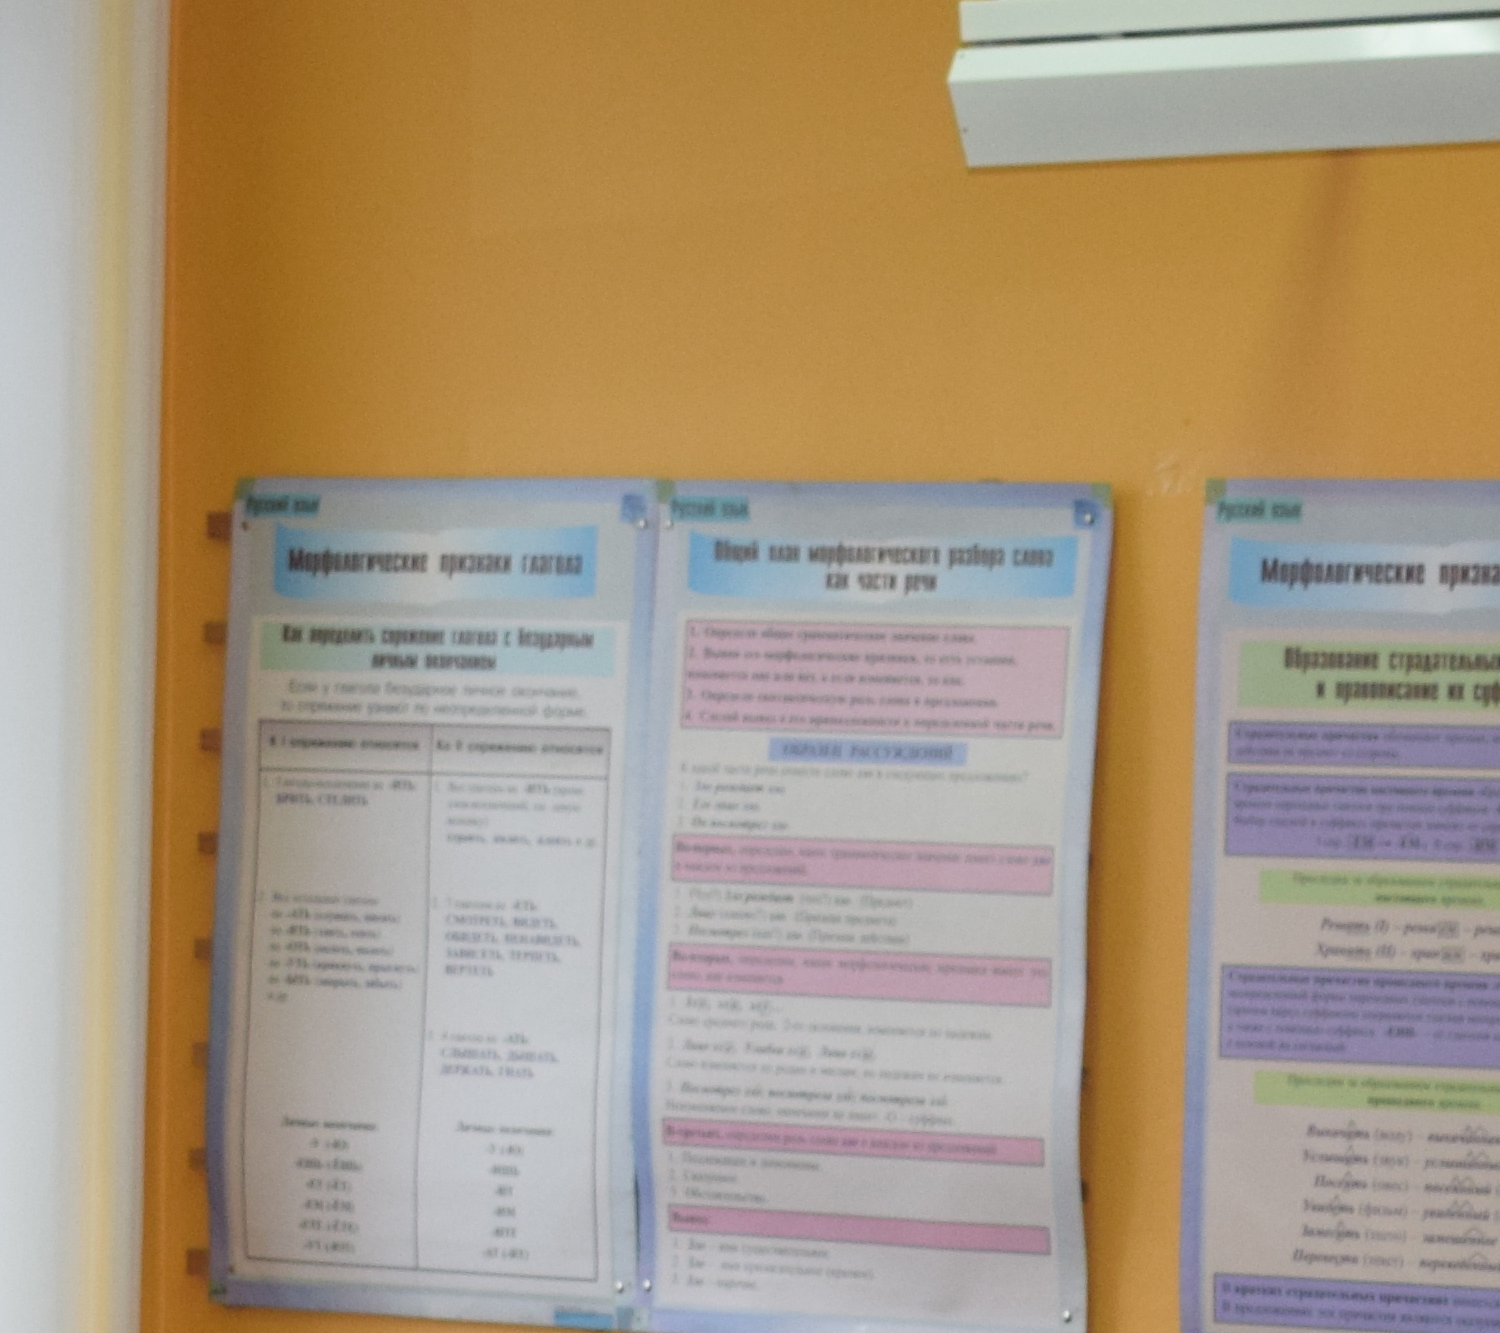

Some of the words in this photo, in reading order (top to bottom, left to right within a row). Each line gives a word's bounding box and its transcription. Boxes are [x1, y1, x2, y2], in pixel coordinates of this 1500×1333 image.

[1217, 499, 1265, 522] Русский
[1272, 502, 1302, 519] язык
[288, 548, 428, 579] Морфологические
[440, 552, 512, 580] признаки
[521, 554, 583, 576] глагола
[714, 540, 759, 564] Общий
[769, 543, 801, 562] план
[809, 542, 940, 568] морфологического
[949, 543, 1006, 570] разбора
[1013, 548, 1055, 568] слова
[825, 572, 849, 590] как
[858, 573, 897, 591] части
[904, 573, 938, 596] речи
[1261, 557, 1426, 590] Морфологические
[282, 624, 301, 643] Как
[310, 627, 375, 647] определить
[518, 627, 594, 652] безударным
[1284, 646, 1380, 674] Образование
[1315, 682, 1326, 699] и
[1335, 682, 1439, 706] правописание
[1447, 684, 1465, 700] их
